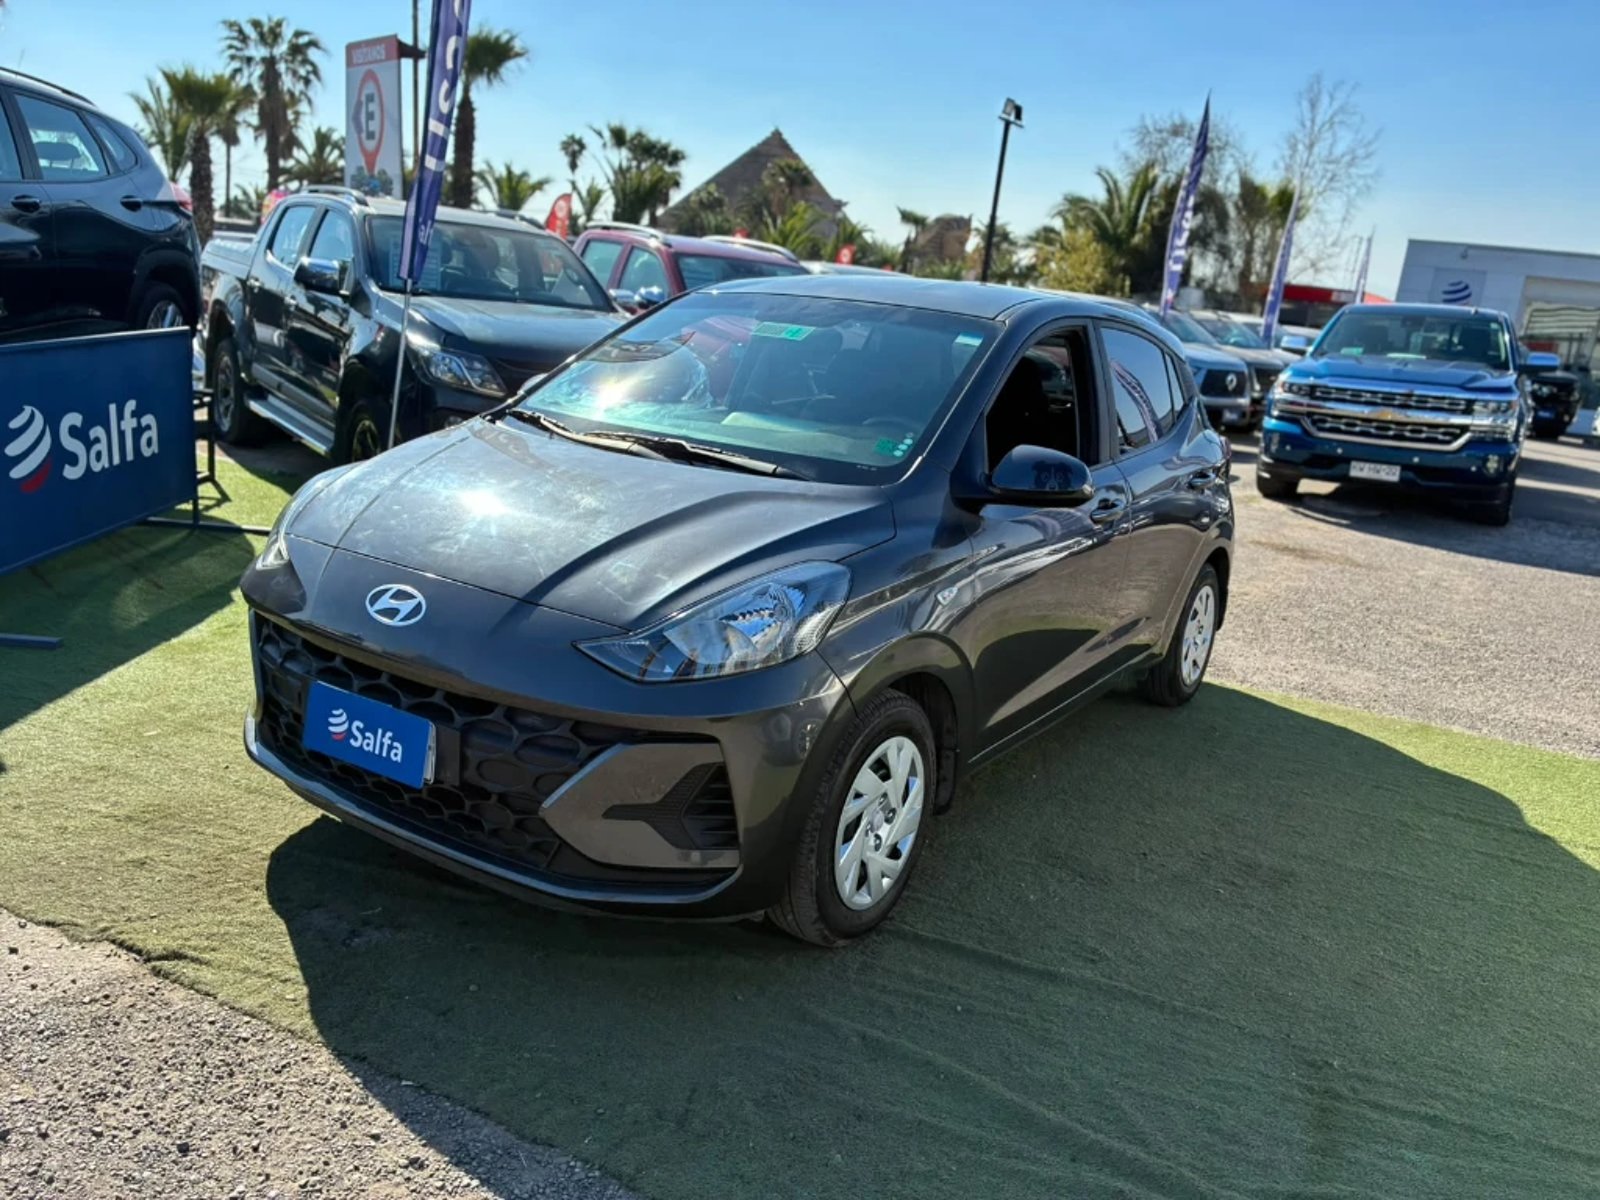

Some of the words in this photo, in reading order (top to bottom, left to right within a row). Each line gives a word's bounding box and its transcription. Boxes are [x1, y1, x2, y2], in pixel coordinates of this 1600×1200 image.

[364, 92, 375, 140] E
[58, 398, 159, 480] Salfa
[349, 719, 403, 763] Salfa
